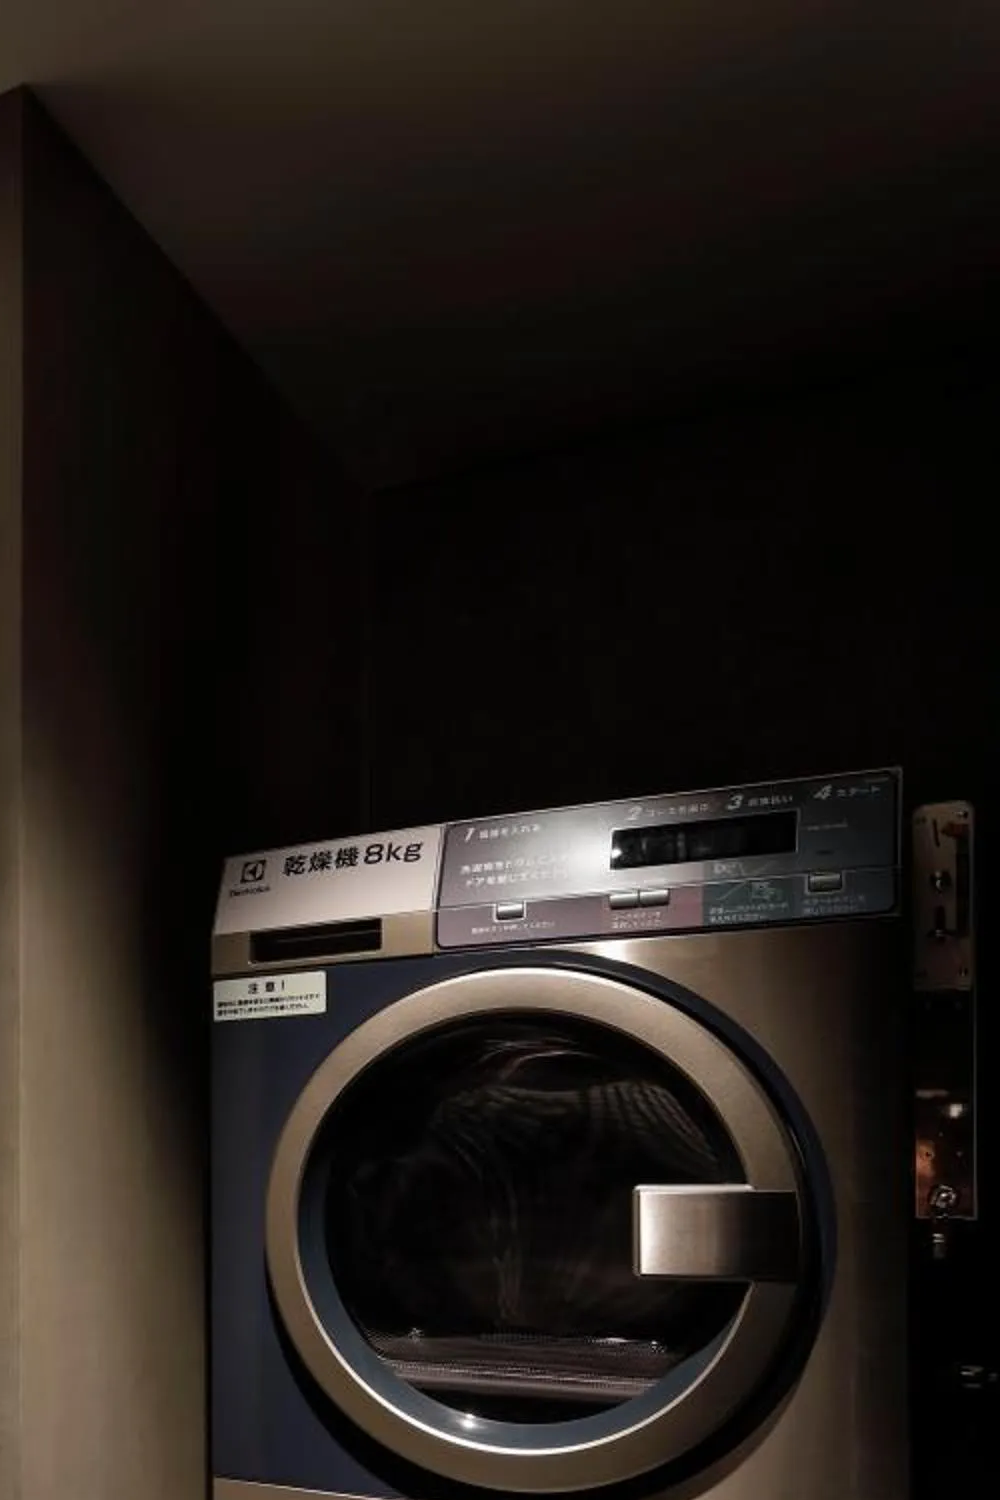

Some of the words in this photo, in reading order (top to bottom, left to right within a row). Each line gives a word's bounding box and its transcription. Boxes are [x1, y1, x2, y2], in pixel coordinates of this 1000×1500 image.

[726, 793, 743, 810] 3
[627, 805, 642, 821] 2
[464, 827, 476, 843] 1
[283, 841, 424, 876] 乾燥機8kg
